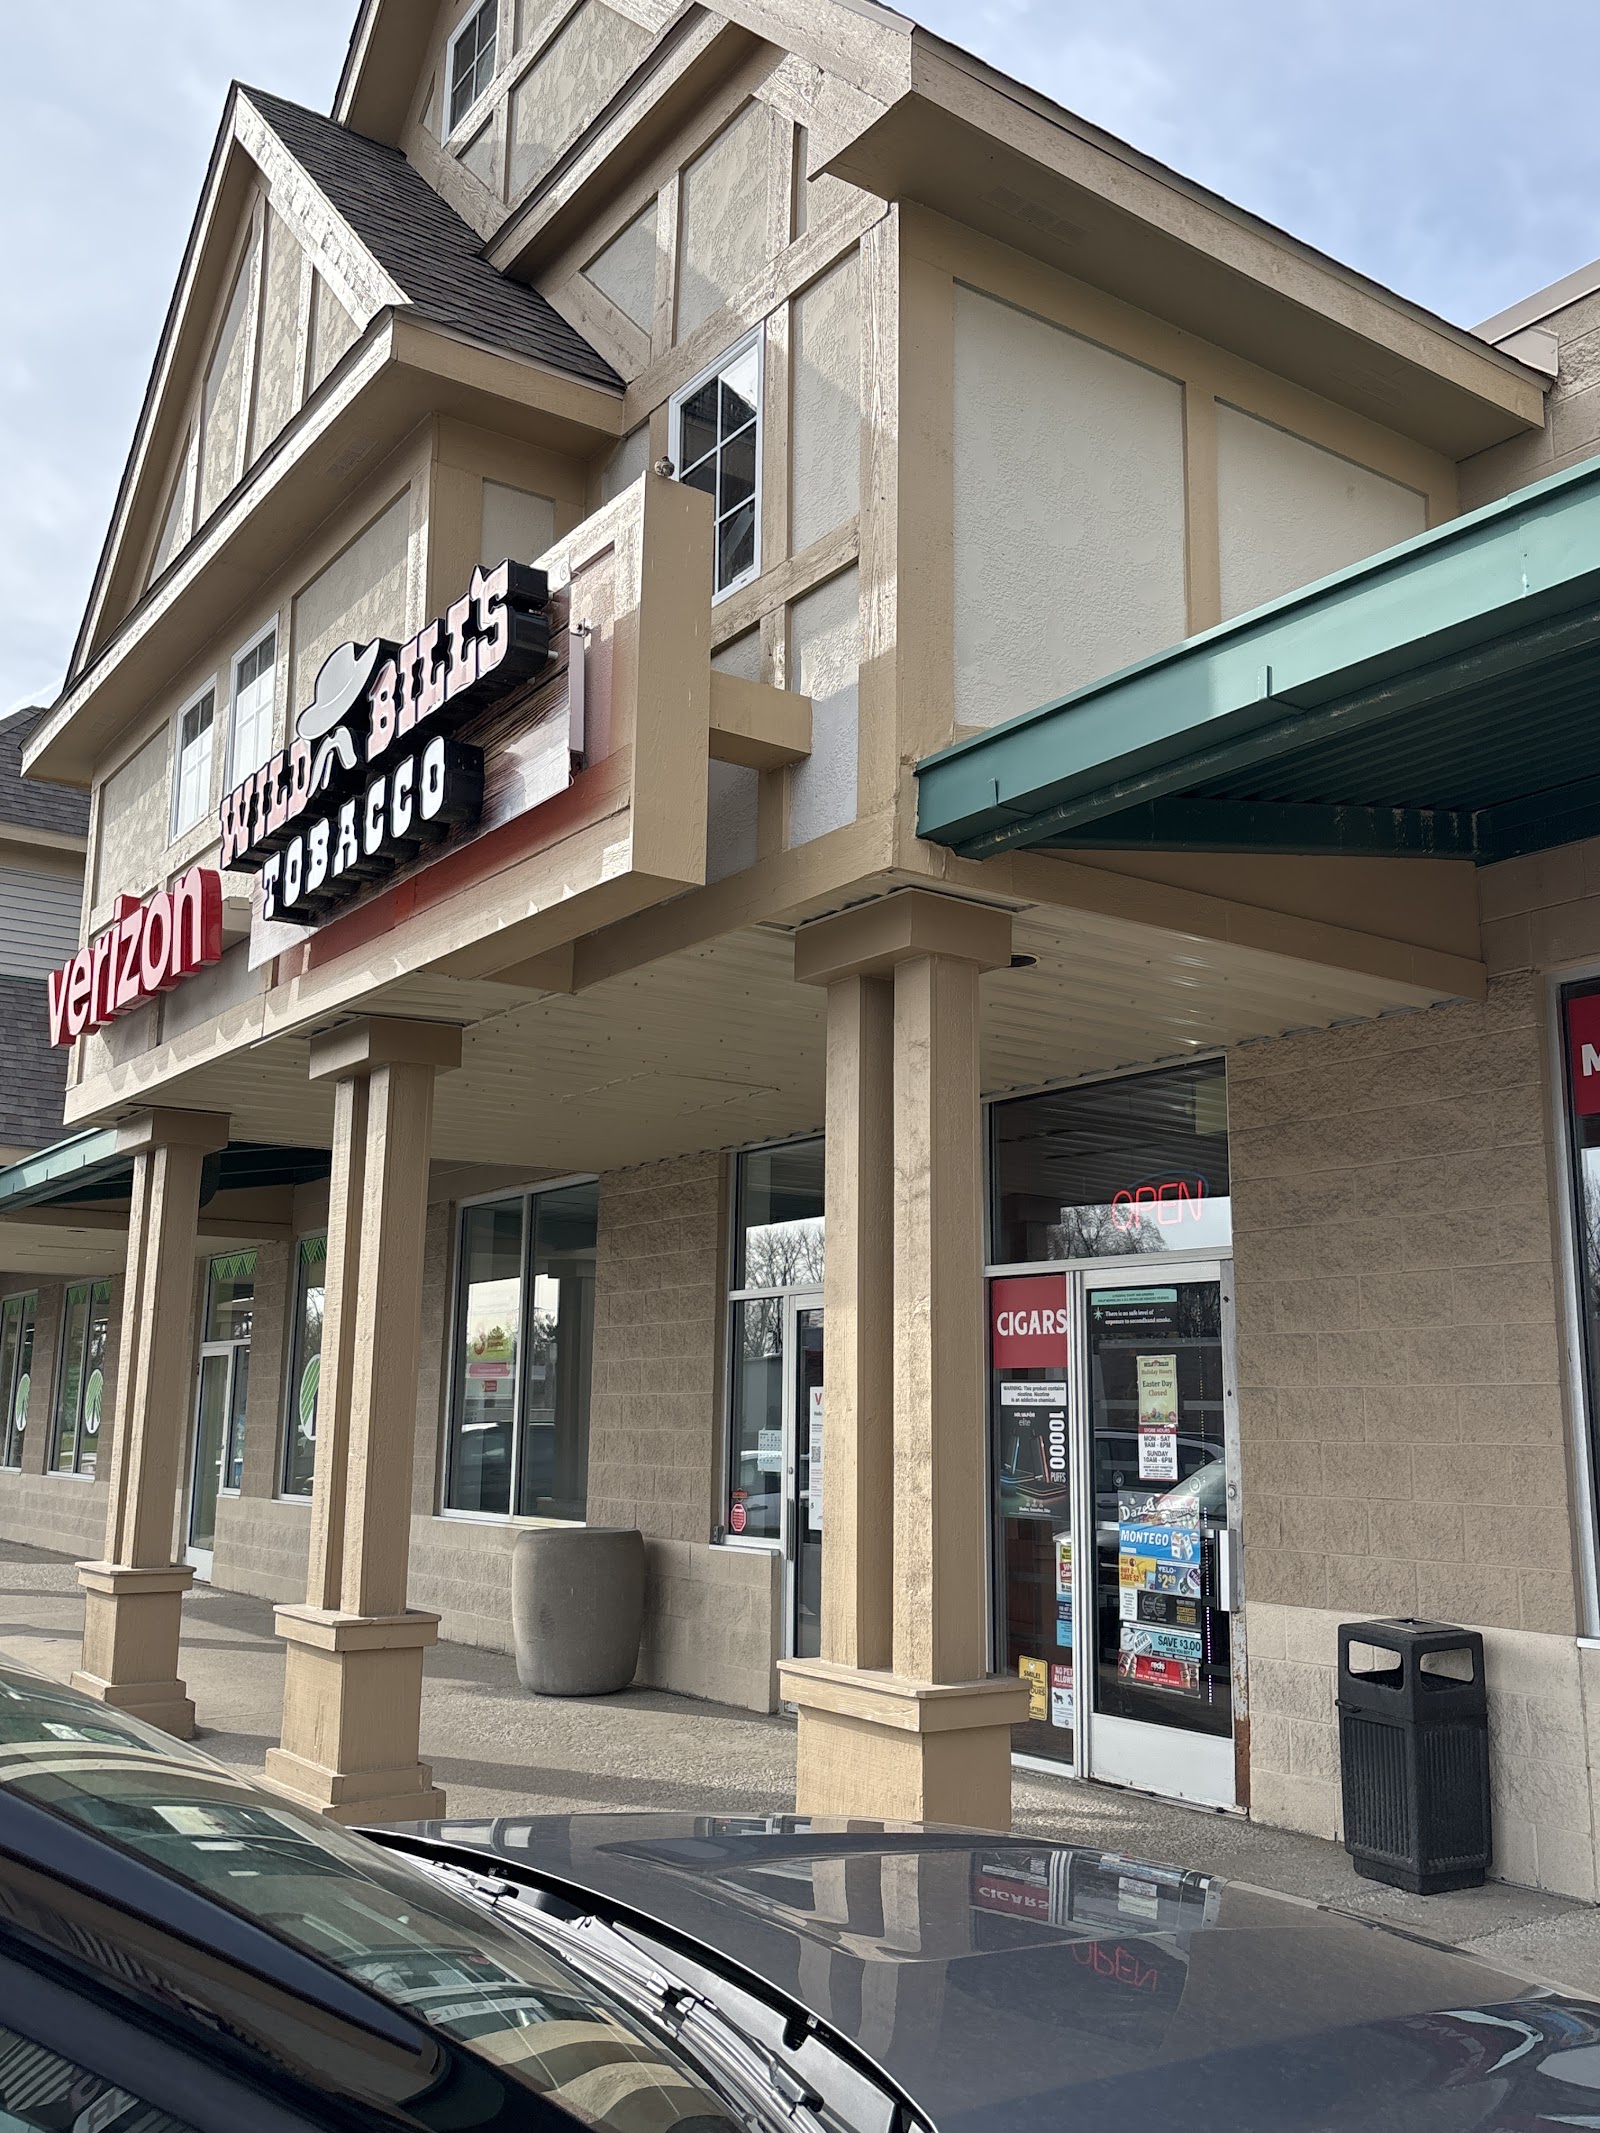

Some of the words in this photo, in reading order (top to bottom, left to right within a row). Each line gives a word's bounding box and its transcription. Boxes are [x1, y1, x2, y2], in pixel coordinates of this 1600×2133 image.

[220, 738, 313, 870] WILD
[366, 558, 512, 763] BILL'S
[262, 736, 447, 922] TOBACCO
[48, 866, 206, 1049] verizon
[1111, 1179, 1204, 1231] OPEN
[996, 1308, 1069, 1336] CIGARS
[1142, 1380, 1160, 1388] Easter
[1161, 1380, 1173, 1388] Day
[1148, 1389, 1168, 1397] Closed
[1048, 1411, 1066, 1470] 10000
[1050, 1471, 1067, 1483] PUFFS
[1119, 1496, 1156, 1521] Dazed
[1120, 1529, 1169, 1547] MONTEGO
[1157, 1635, 1178, 1648] SAVE
[1179, 1639, 1201, 1652] $3.00
[1023, 1670, 1041, 1680] SMILE!
[1055, 1667, 1063, 1675] NO
[1063, 1668, 1073, 1676] PET
